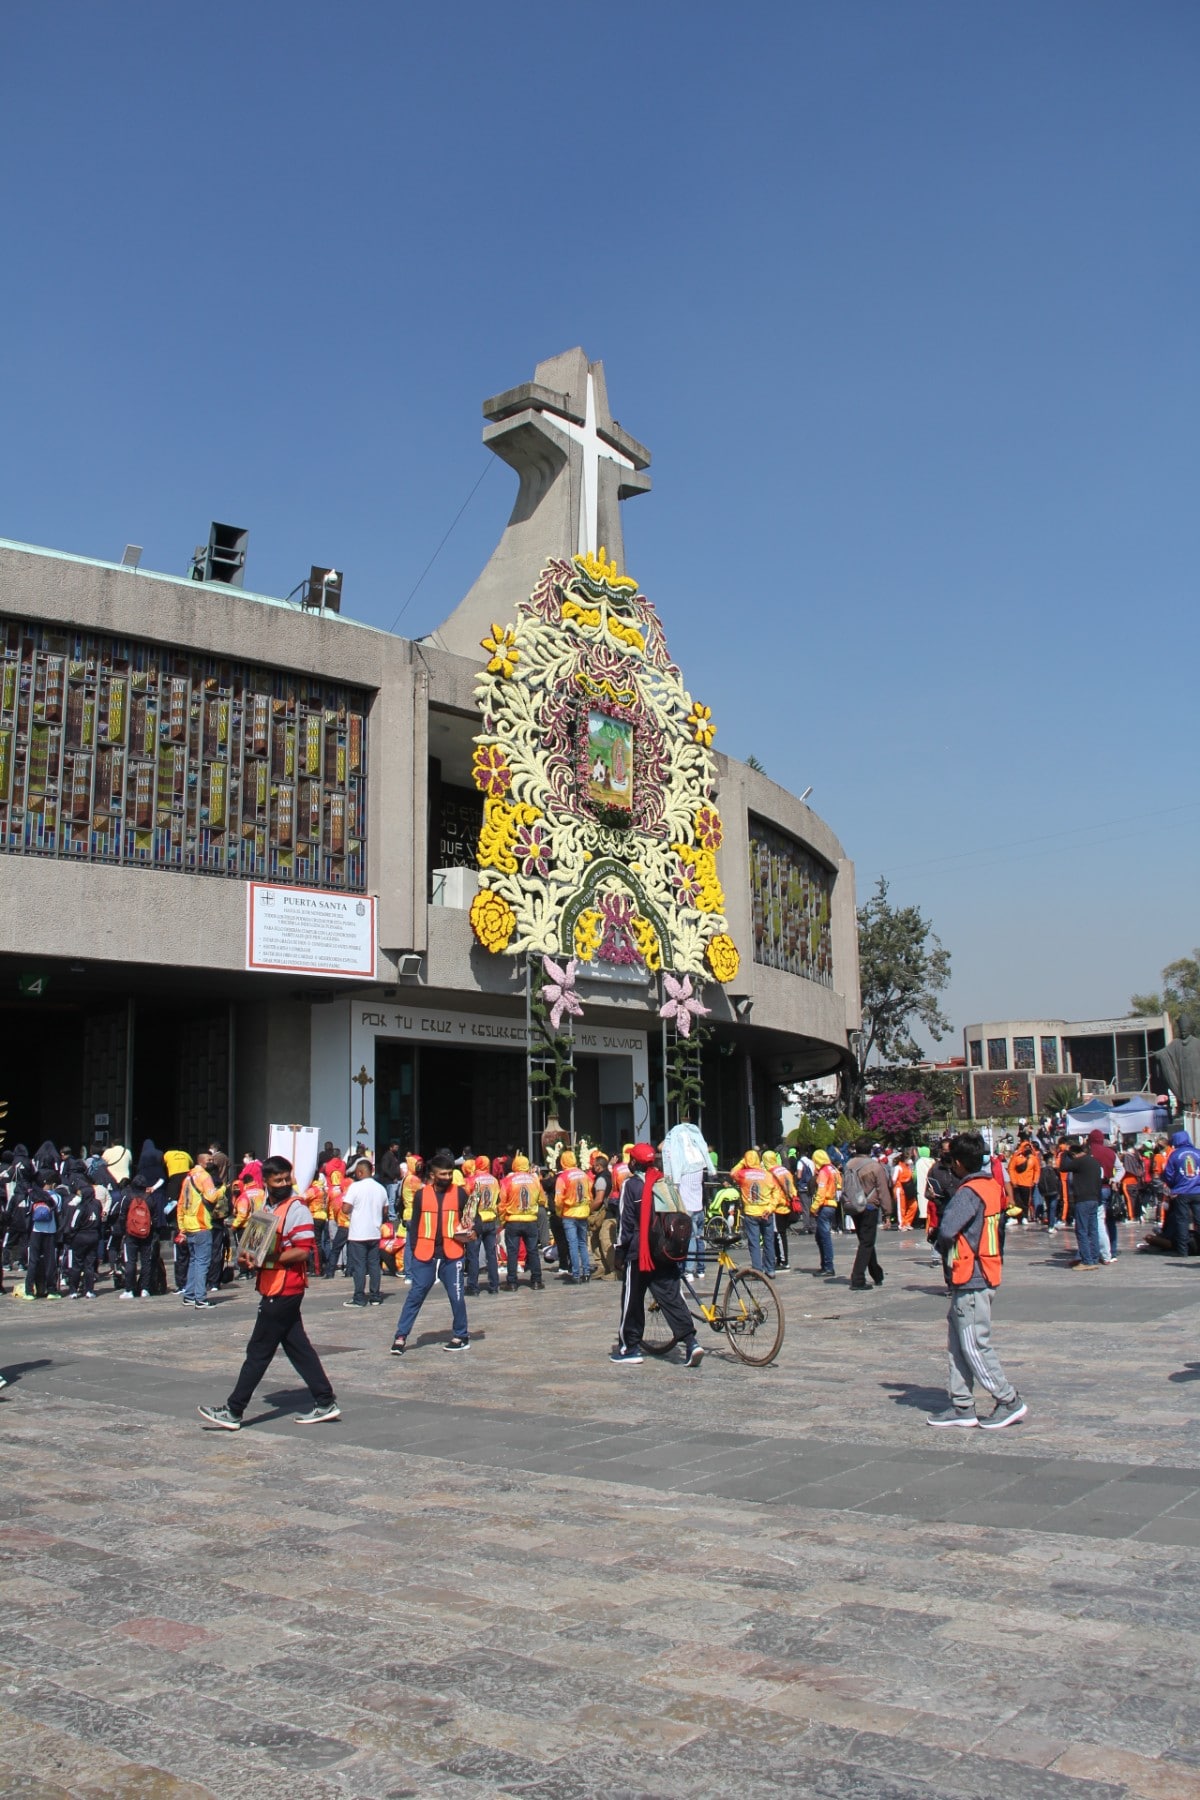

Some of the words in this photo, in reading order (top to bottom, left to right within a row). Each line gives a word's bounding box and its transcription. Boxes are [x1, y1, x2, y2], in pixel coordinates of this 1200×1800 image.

[283, 896, 317, 908] PUERTA
[319, 900, 348, 912] SANTA
[28, 978, 42, 995] 4
[361, 1012, 387, 1027] POR
[395, 1013, 412, 1030] TU
[421, 1018, 452, 1034] CRUZ
[459, 1022, 466, 1035] Y
[581, 1033, 597, 1047] HAS
[603, 1035, 643, 1051] SALVADO
